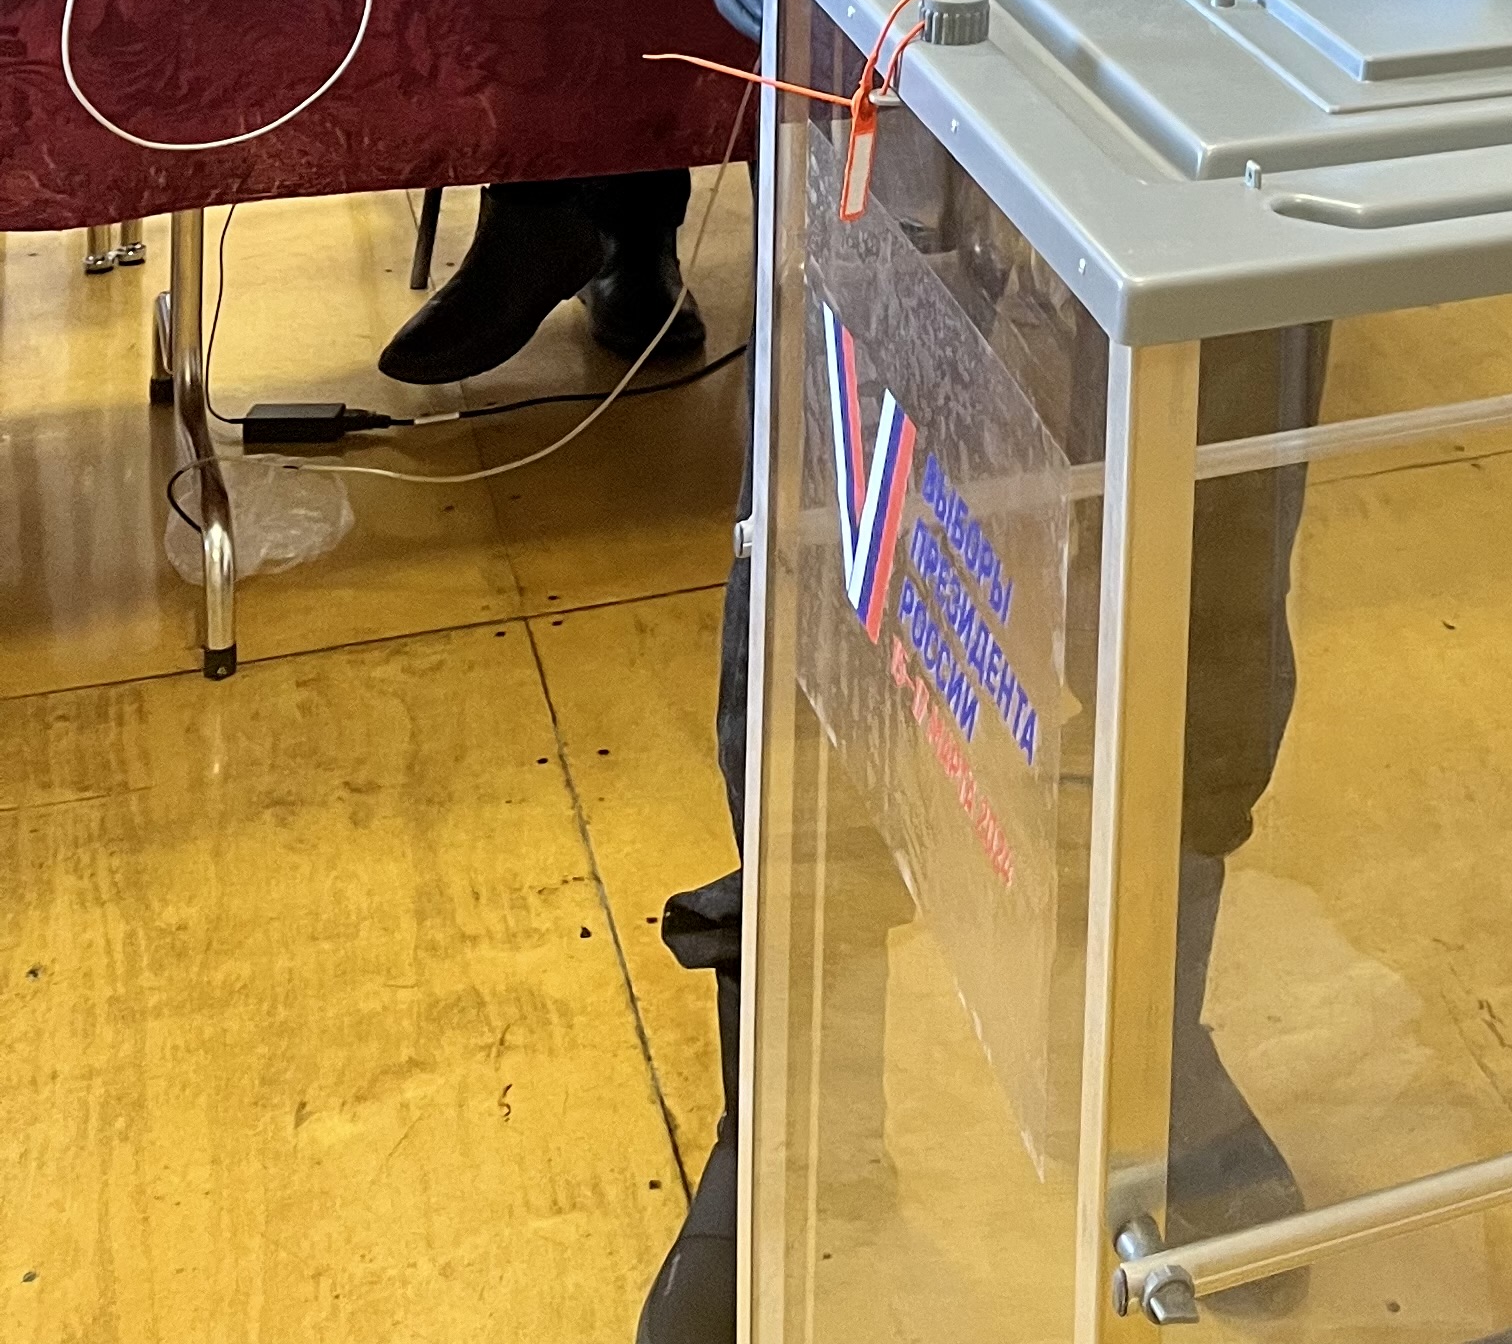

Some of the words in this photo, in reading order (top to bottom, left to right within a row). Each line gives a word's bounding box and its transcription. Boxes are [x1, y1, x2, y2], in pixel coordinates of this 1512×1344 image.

[922, 452, 1014, 628] ВЫБОРЫ
[900, 575, 980, 744] РОССИИ
[910, 516, 1037, 766] ПРЕЗИДЕНТА
